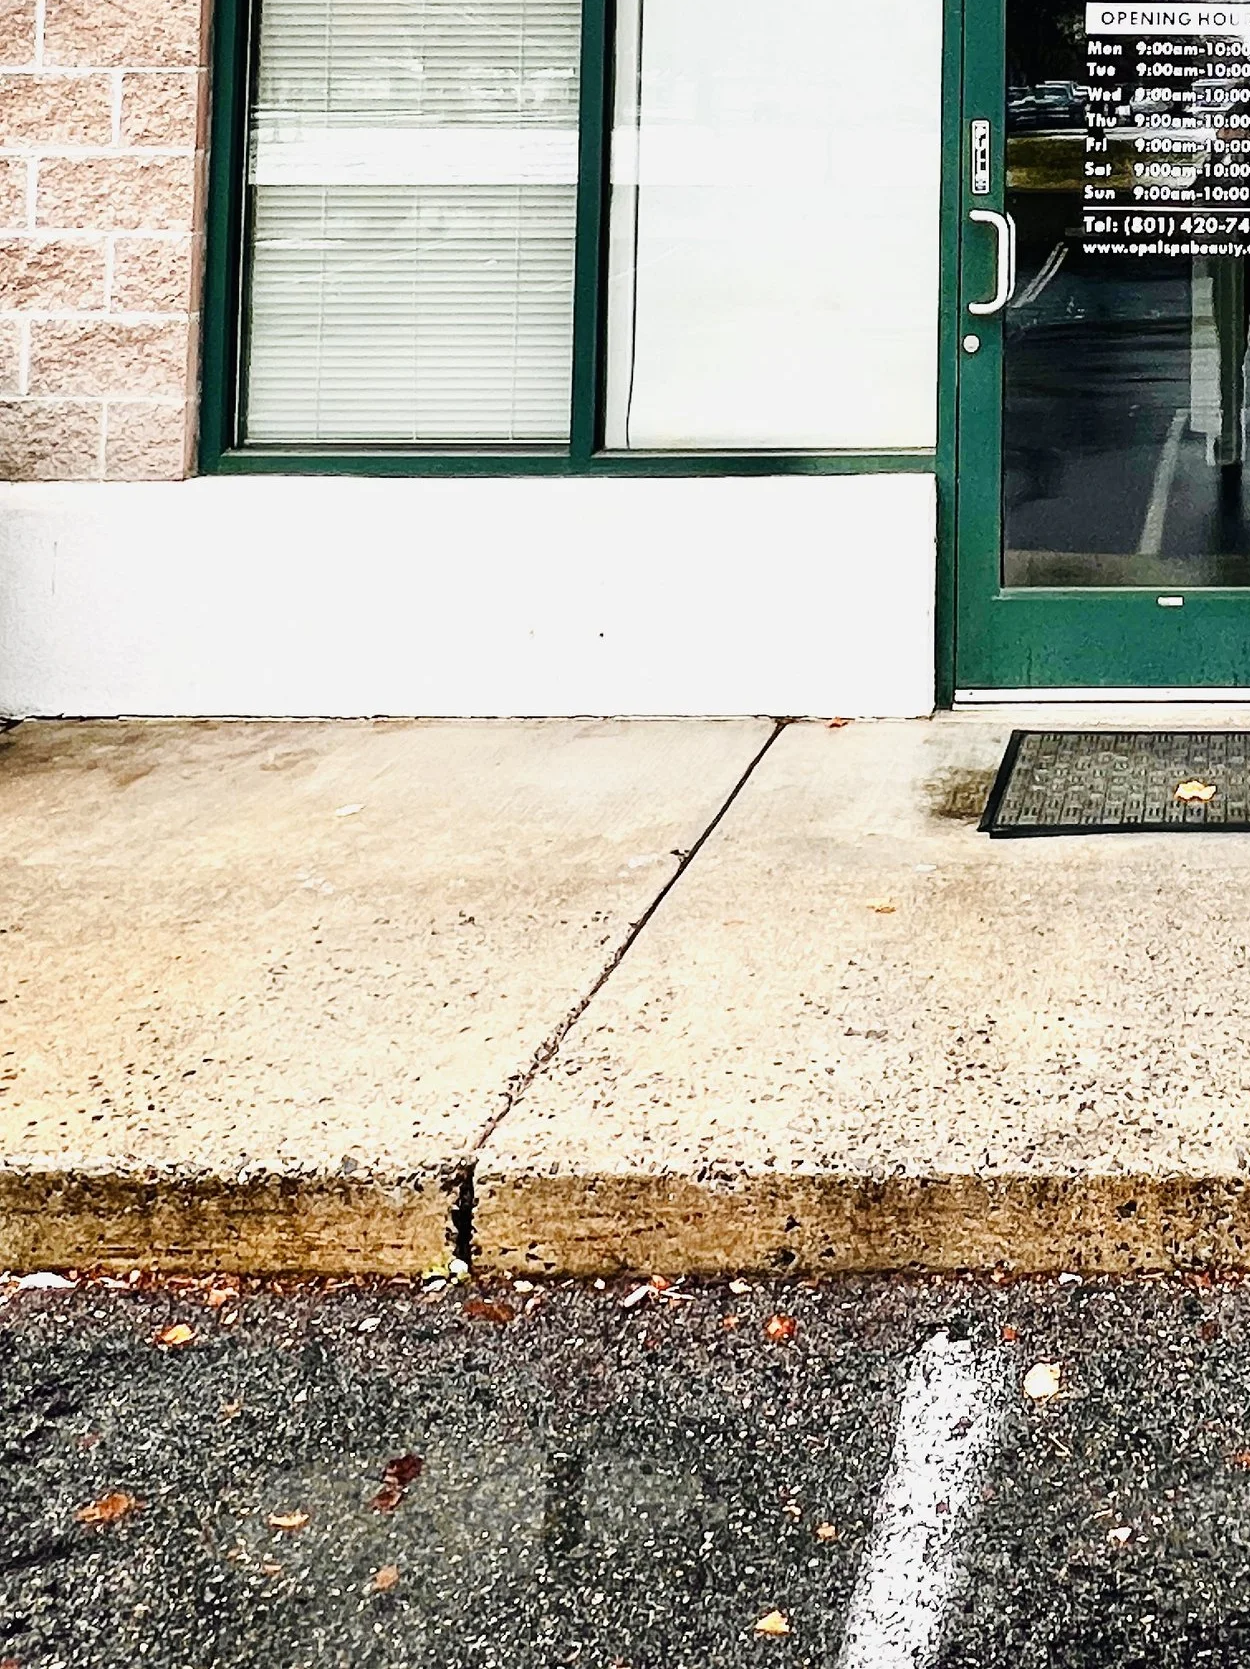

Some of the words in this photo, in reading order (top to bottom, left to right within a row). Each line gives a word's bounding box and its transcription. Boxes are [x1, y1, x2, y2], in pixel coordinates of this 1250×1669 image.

[1101, 12, 1192, 25] OPENING
[1087, 41, 1122, 56] Mon
[1086, 62, 1116, 77] Tue
[1088, 87, 1122, 102] Wed
[1086, 113, 1117, 128] Thu
[1085, 138, 1108, 152] Fri
[1084, 162, 1112, 177] Sat
[1083, 185, 1116, 200] Sun
[1083, 216, 1119, 234] Tel:
[1123, 216, 1175, 237] (801)
